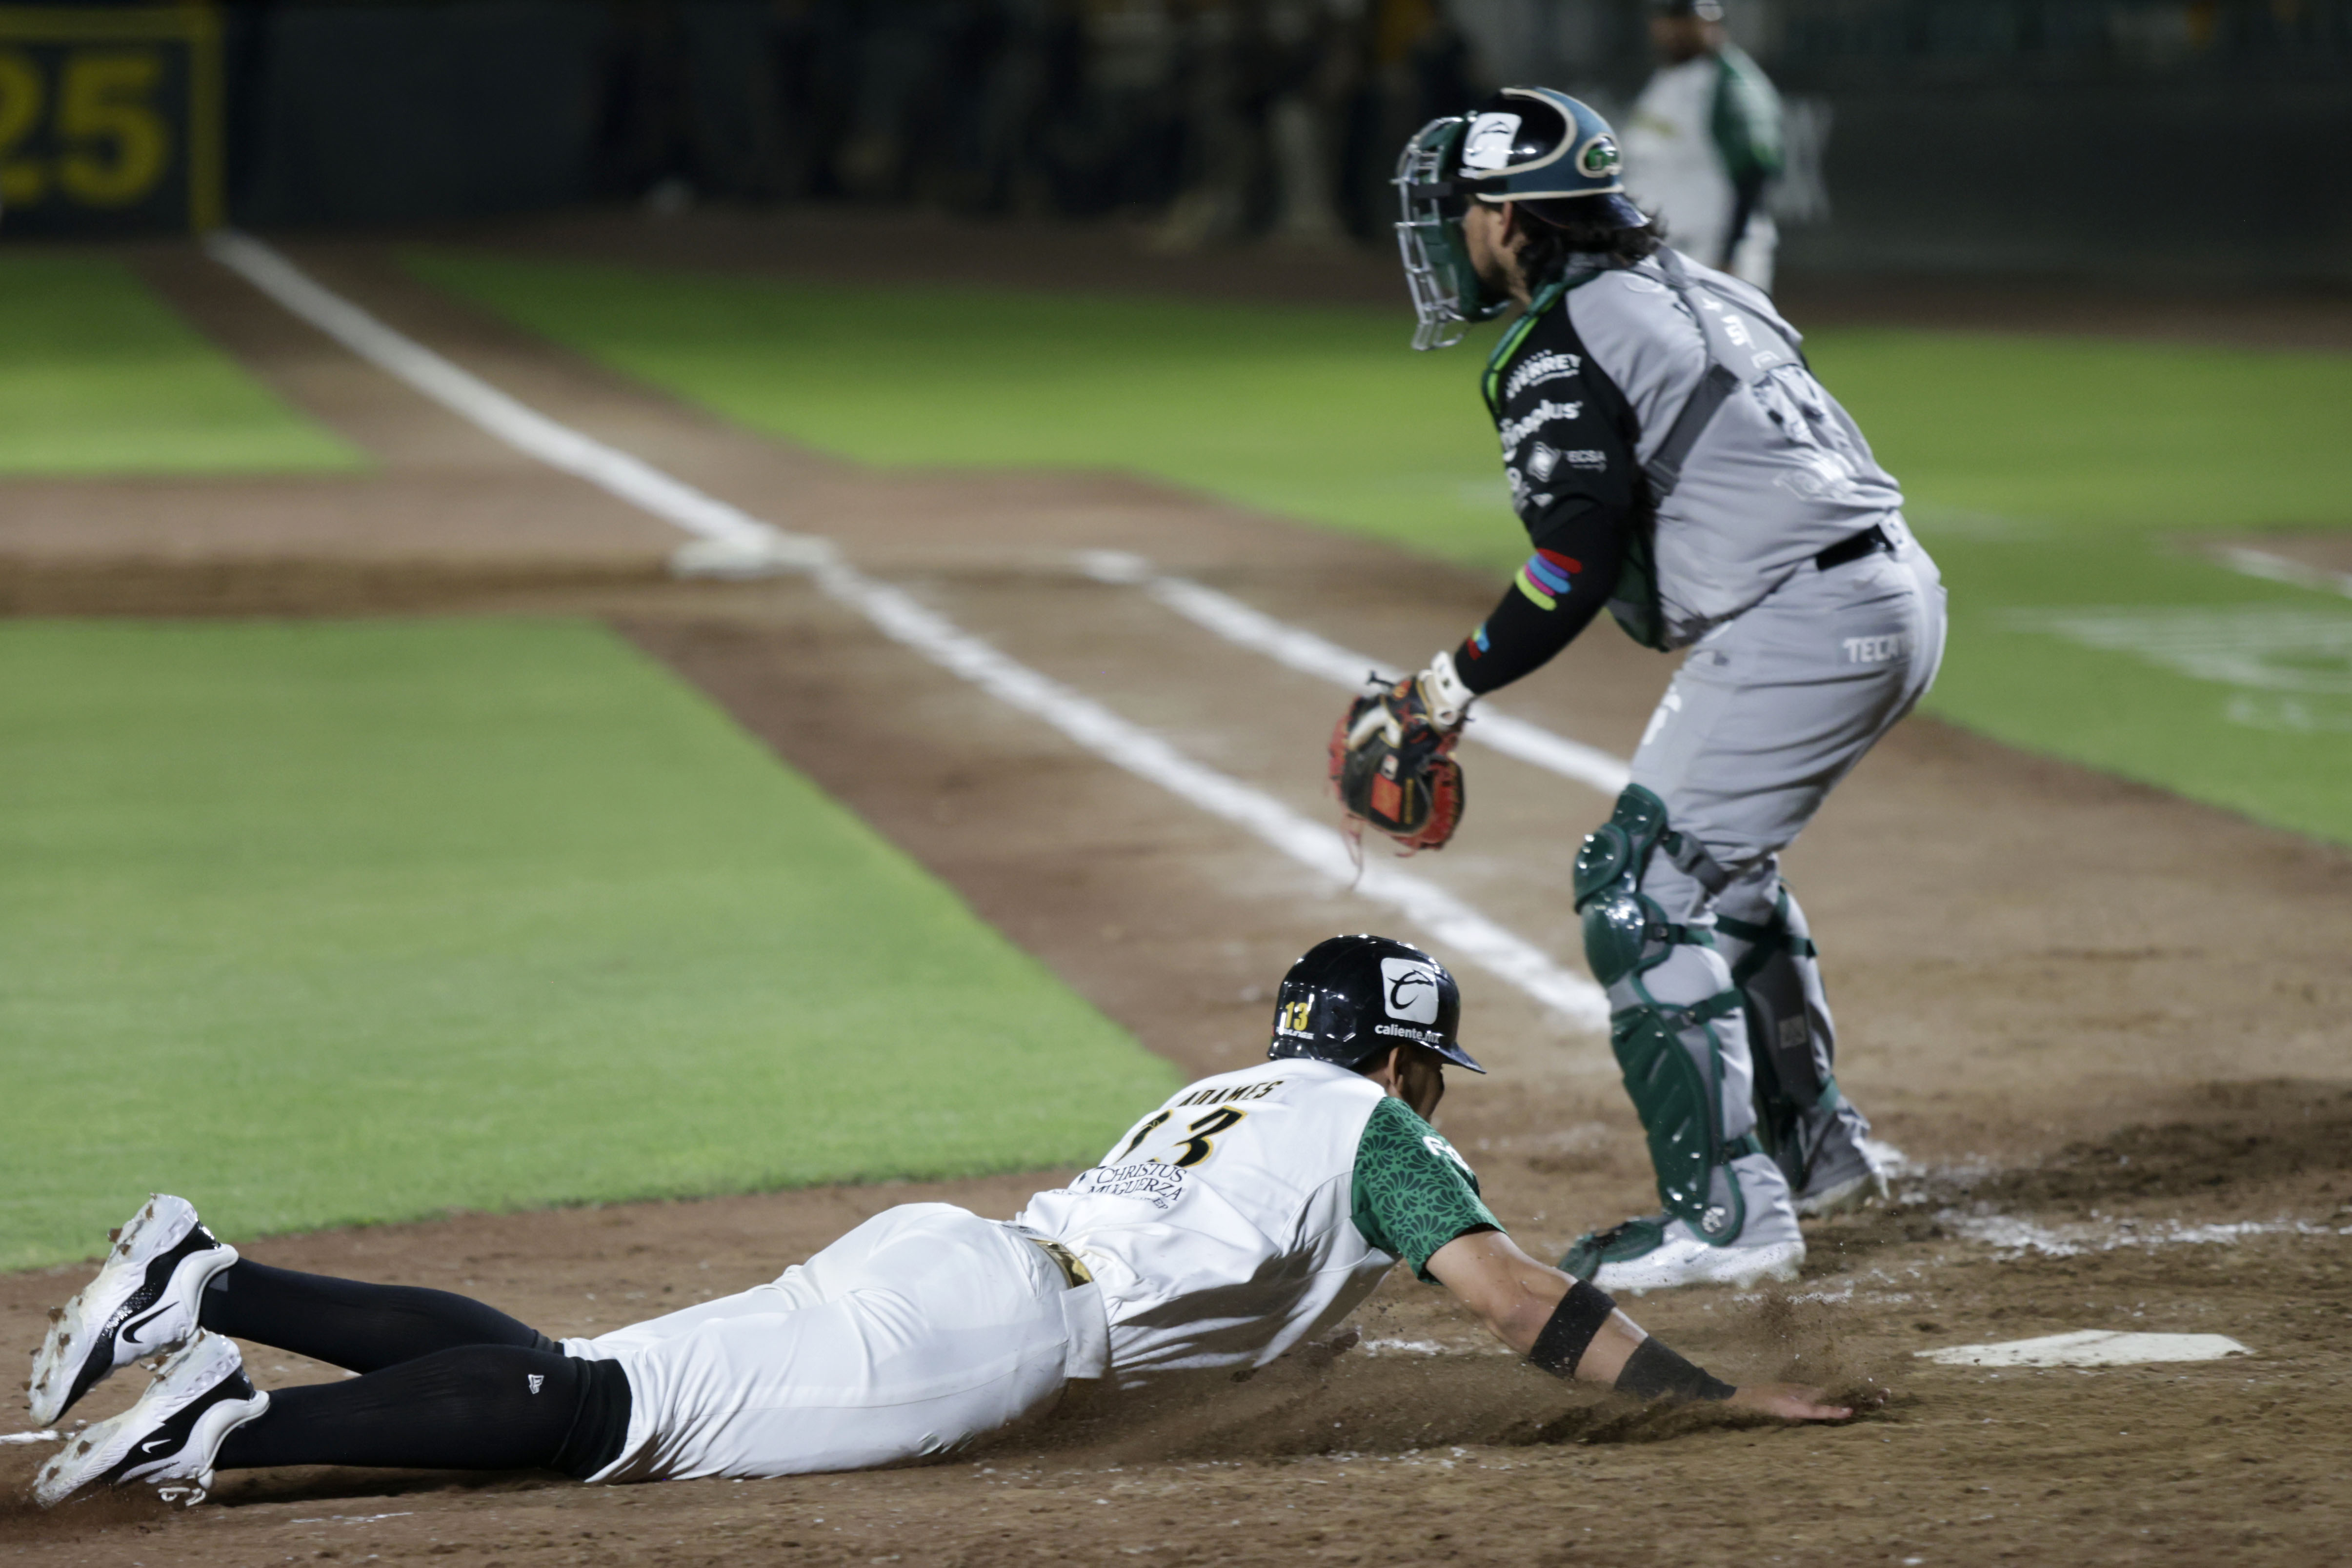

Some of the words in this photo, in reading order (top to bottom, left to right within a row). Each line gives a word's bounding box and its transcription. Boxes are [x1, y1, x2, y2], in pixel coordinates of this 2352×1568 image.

[1285, 1001, 1309, 1031] 13
[1374, 1024, 1440, 1044] caliente.mx
[1097, 1163, 1186, 1183] CHRISTUS
[1087, 1178, 1183, 1201] MUGUERZA
